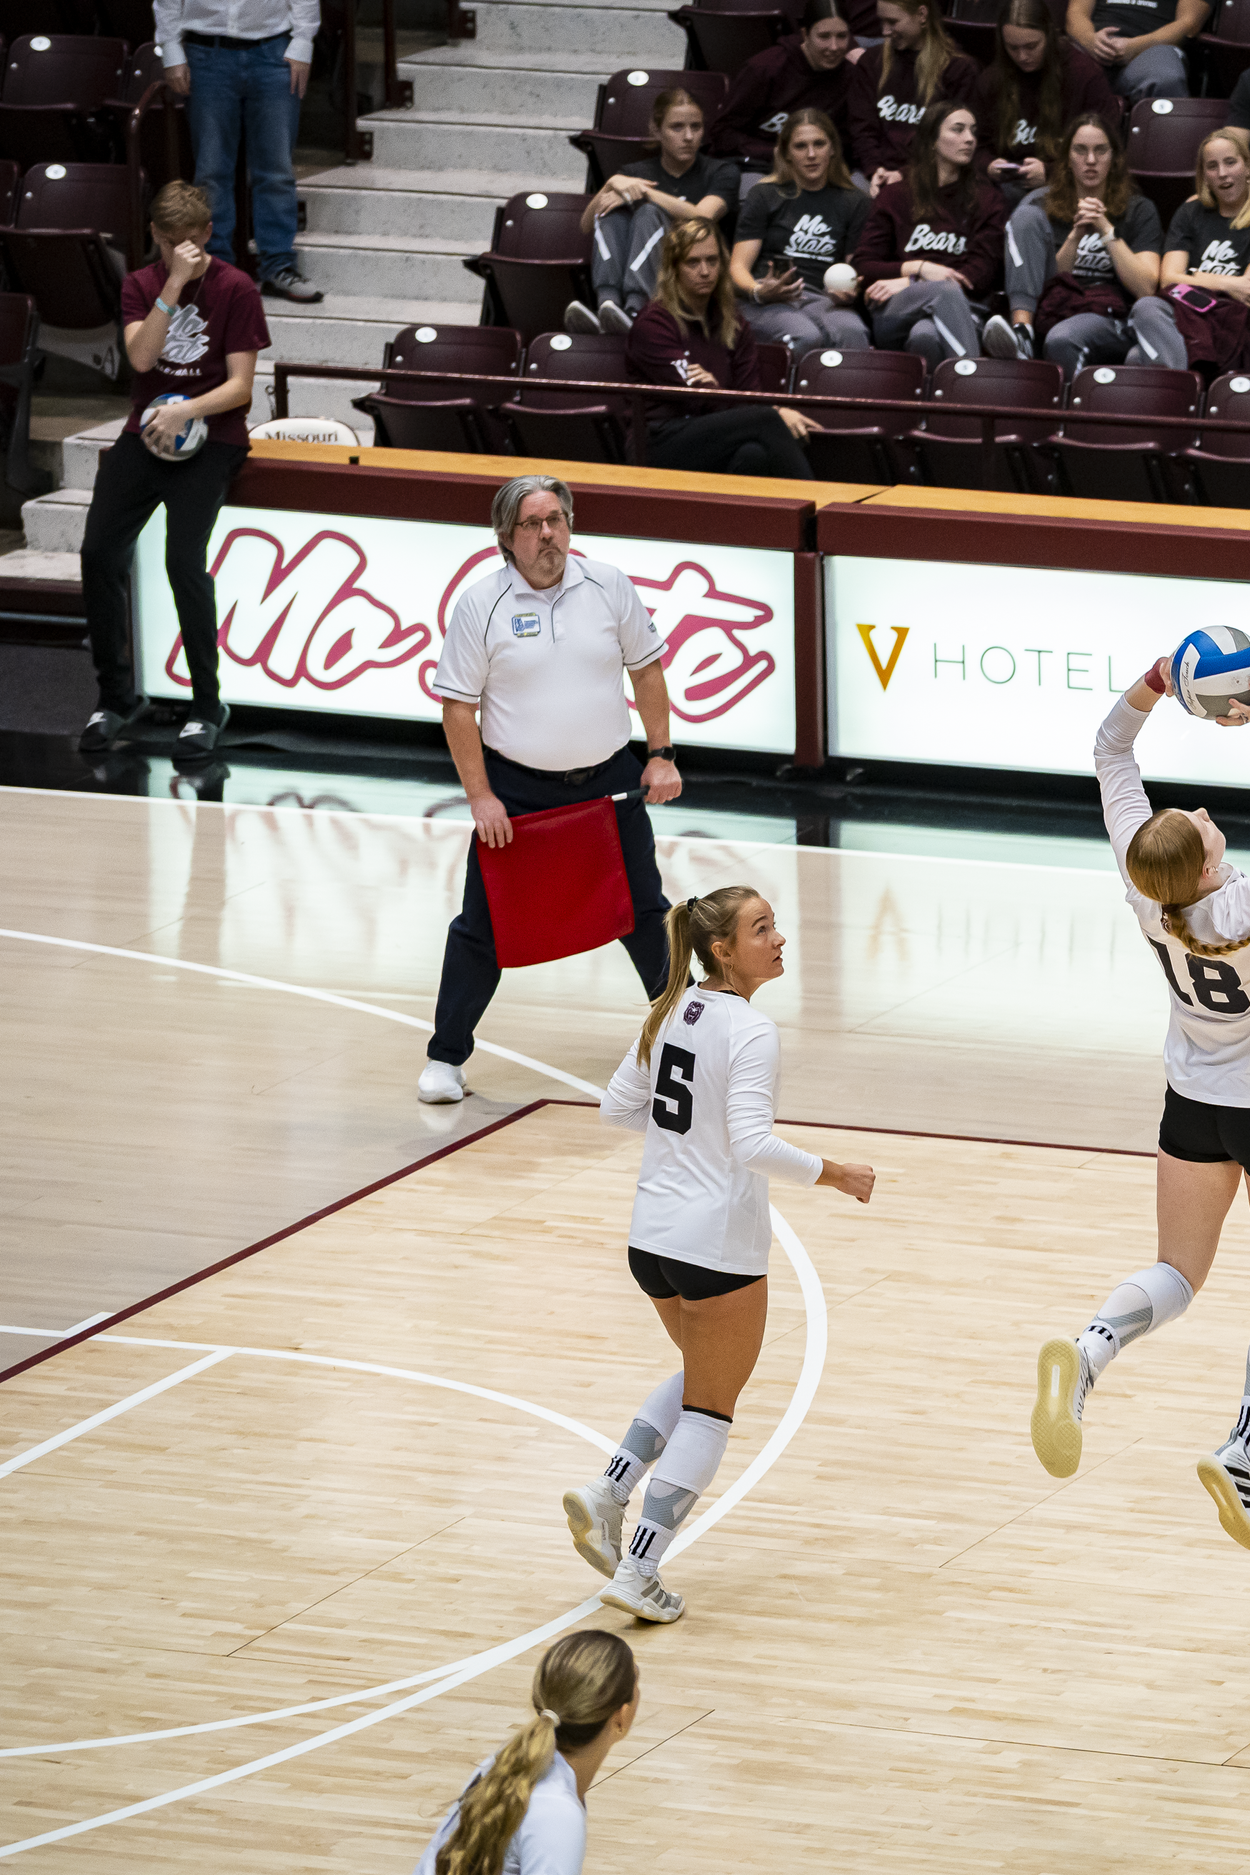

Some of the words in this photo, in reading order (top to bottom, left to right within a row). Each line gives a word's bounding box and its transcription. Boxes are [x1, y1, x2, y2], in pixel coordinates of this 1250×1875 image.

[793, 214, 832, 235] Mo
[904, 224, 968, 255] Bears
[784, 231, 837, 256] State
[1201, 240, 1239, 261] Mo
[264, 430, 340, 443] Missouri
[165, 527, 432, 691] Mo
[856, 623, 911, 692] V
[933, 642, 1126, 694] HOTEL
[651, 1042, 696, 1136] 5
